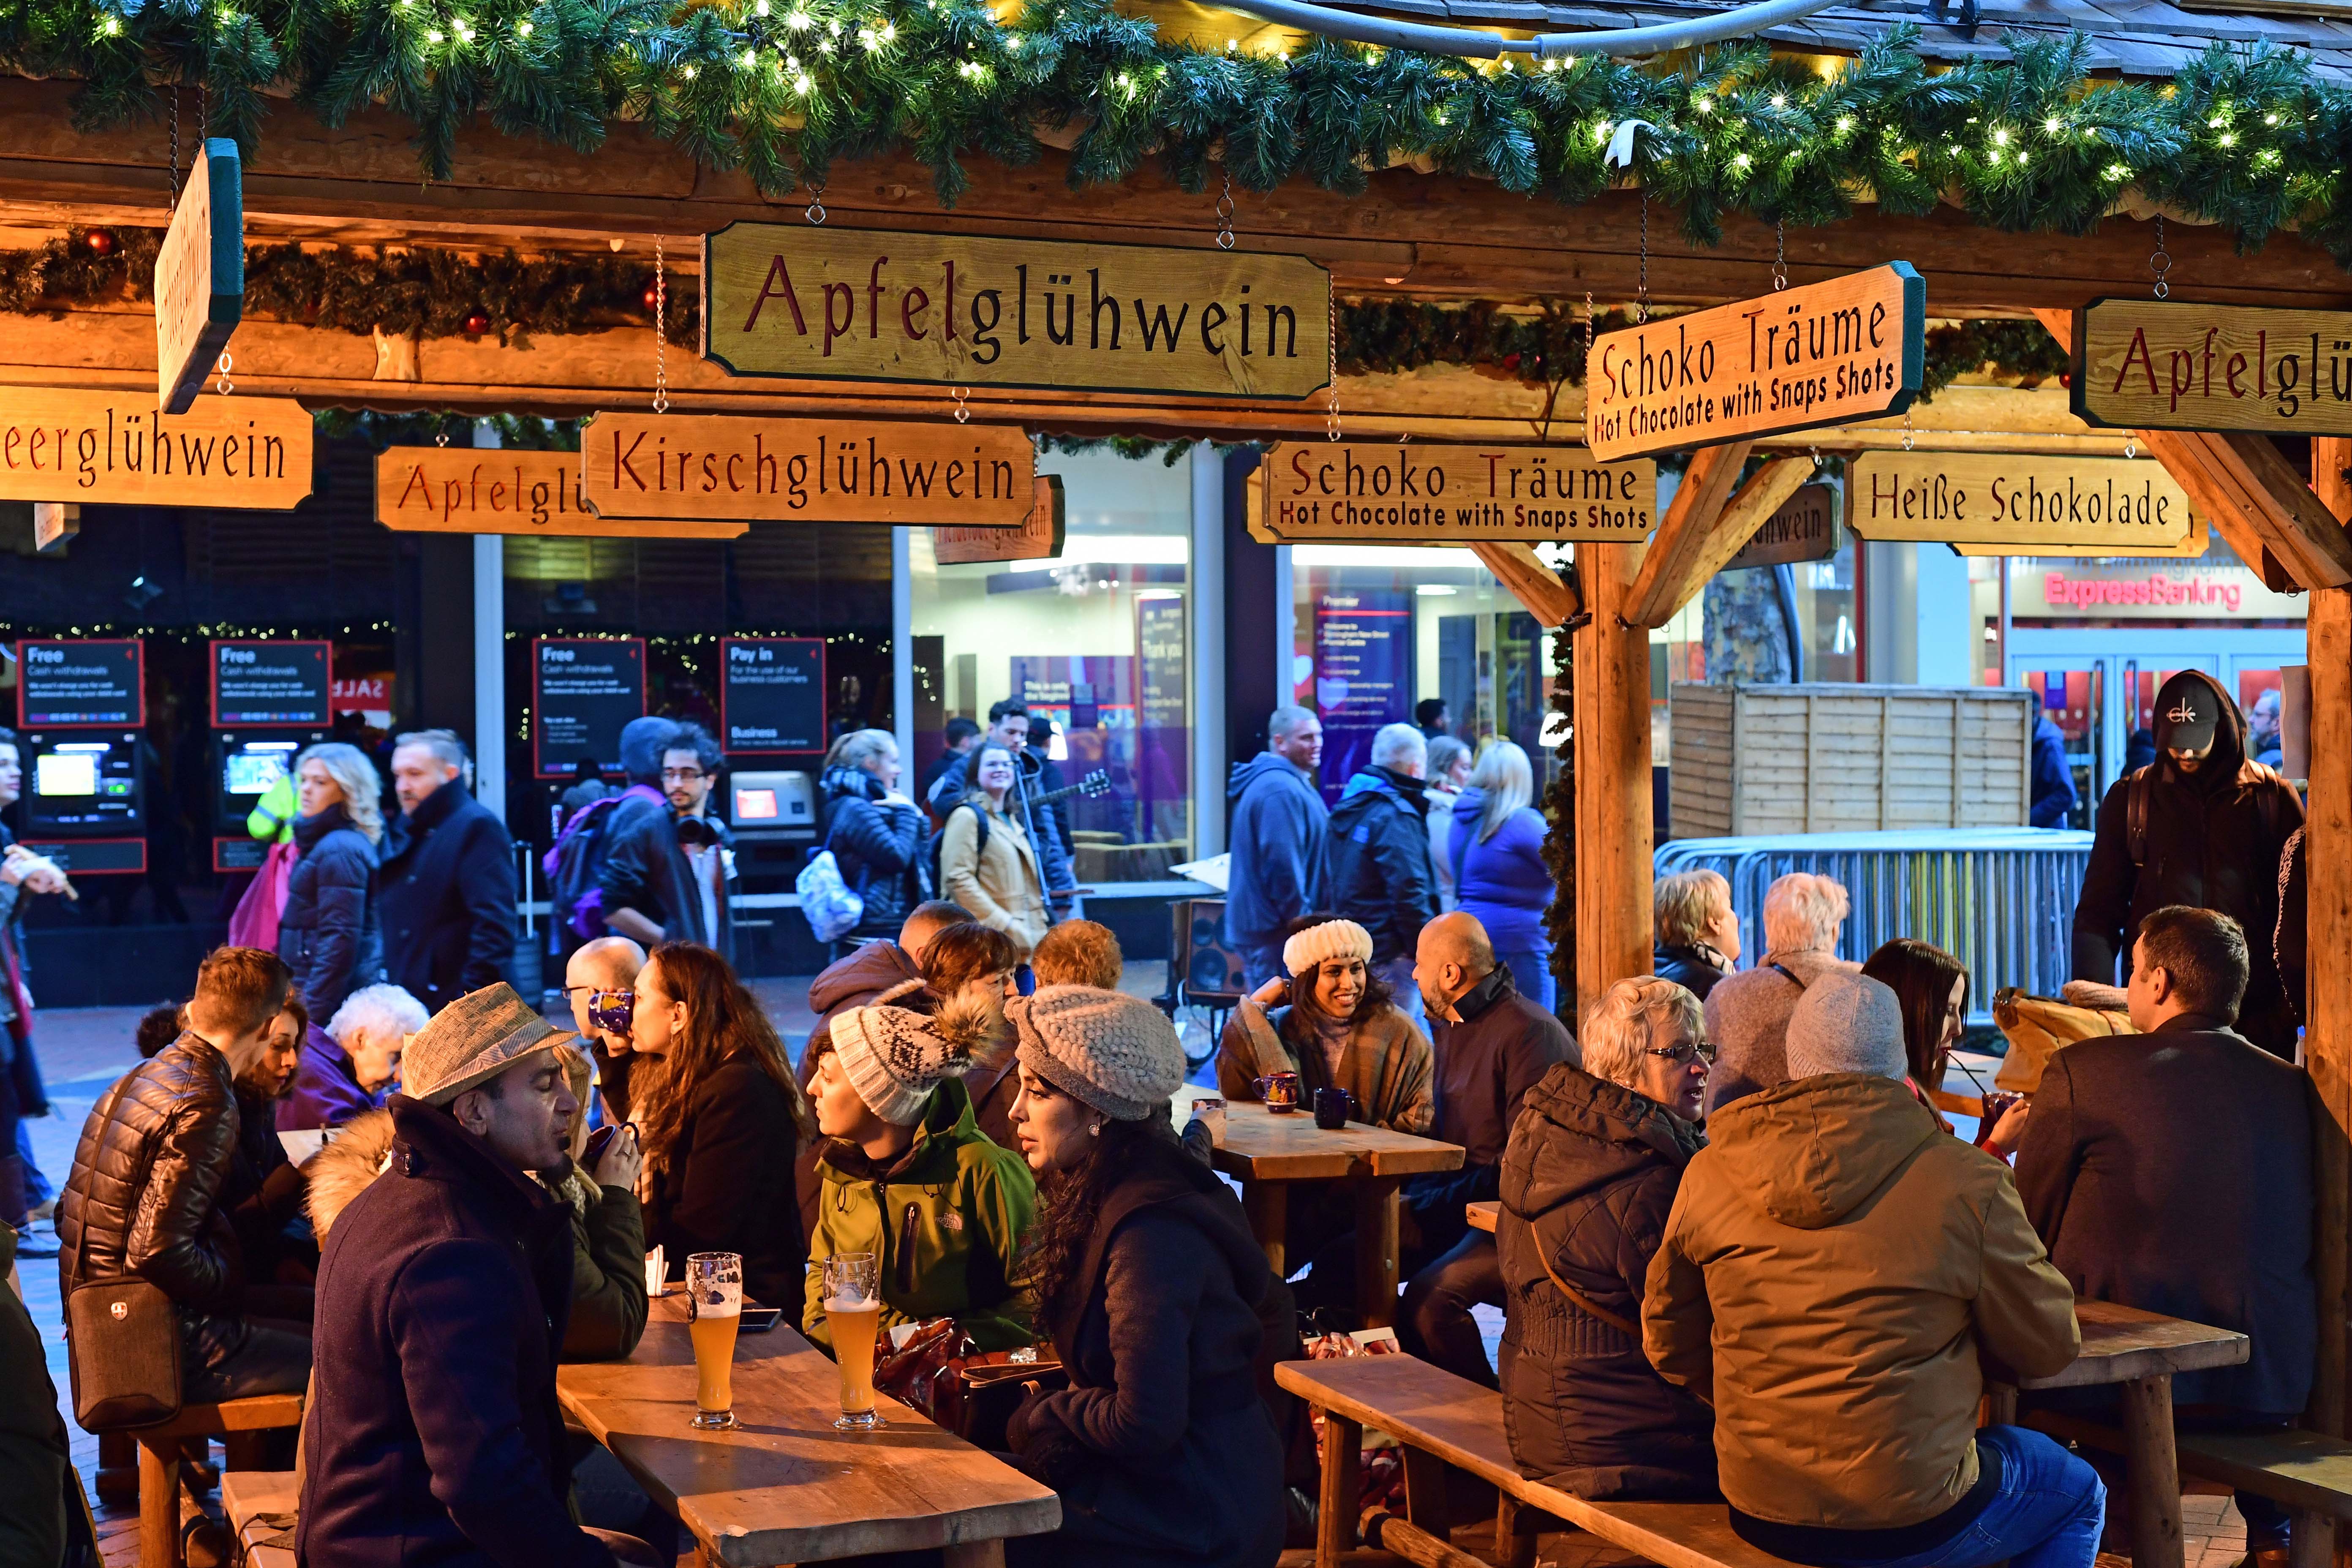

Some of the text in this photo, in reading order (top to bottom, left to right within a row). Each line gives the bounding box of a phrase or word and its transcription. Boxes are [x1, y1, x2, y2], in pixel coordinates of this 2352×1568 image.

[743, 254, 1298, 365] Apfelglühwein
[1602, 302, 1886, 404] Schoko Träume
[2112, 327, 2352, 418] Apfelglü
[1594, 357, 1894, 443] Hot Chocolate with Snaps Shots
[5, 408, 284, 488] eerglühwein
[613, 430, 1015, 509] Kirschglühwein
[1292, 449, 1637, 501] Schoko Träume
[1872, 473, 1966, 521] Heiße
[1991, 475, 2169, 526] Schokolade
[1279, 501, 1647, 534] Hot Chocolate with Snaps Shots
[2044, 572, 2241, 611] ExpressBanking
[28, 647, 64, 663] Free
[221, 647, 256, 663] Free
[542, 647, 575, 662] Free
[730, 646, 773, 664] Pay in
